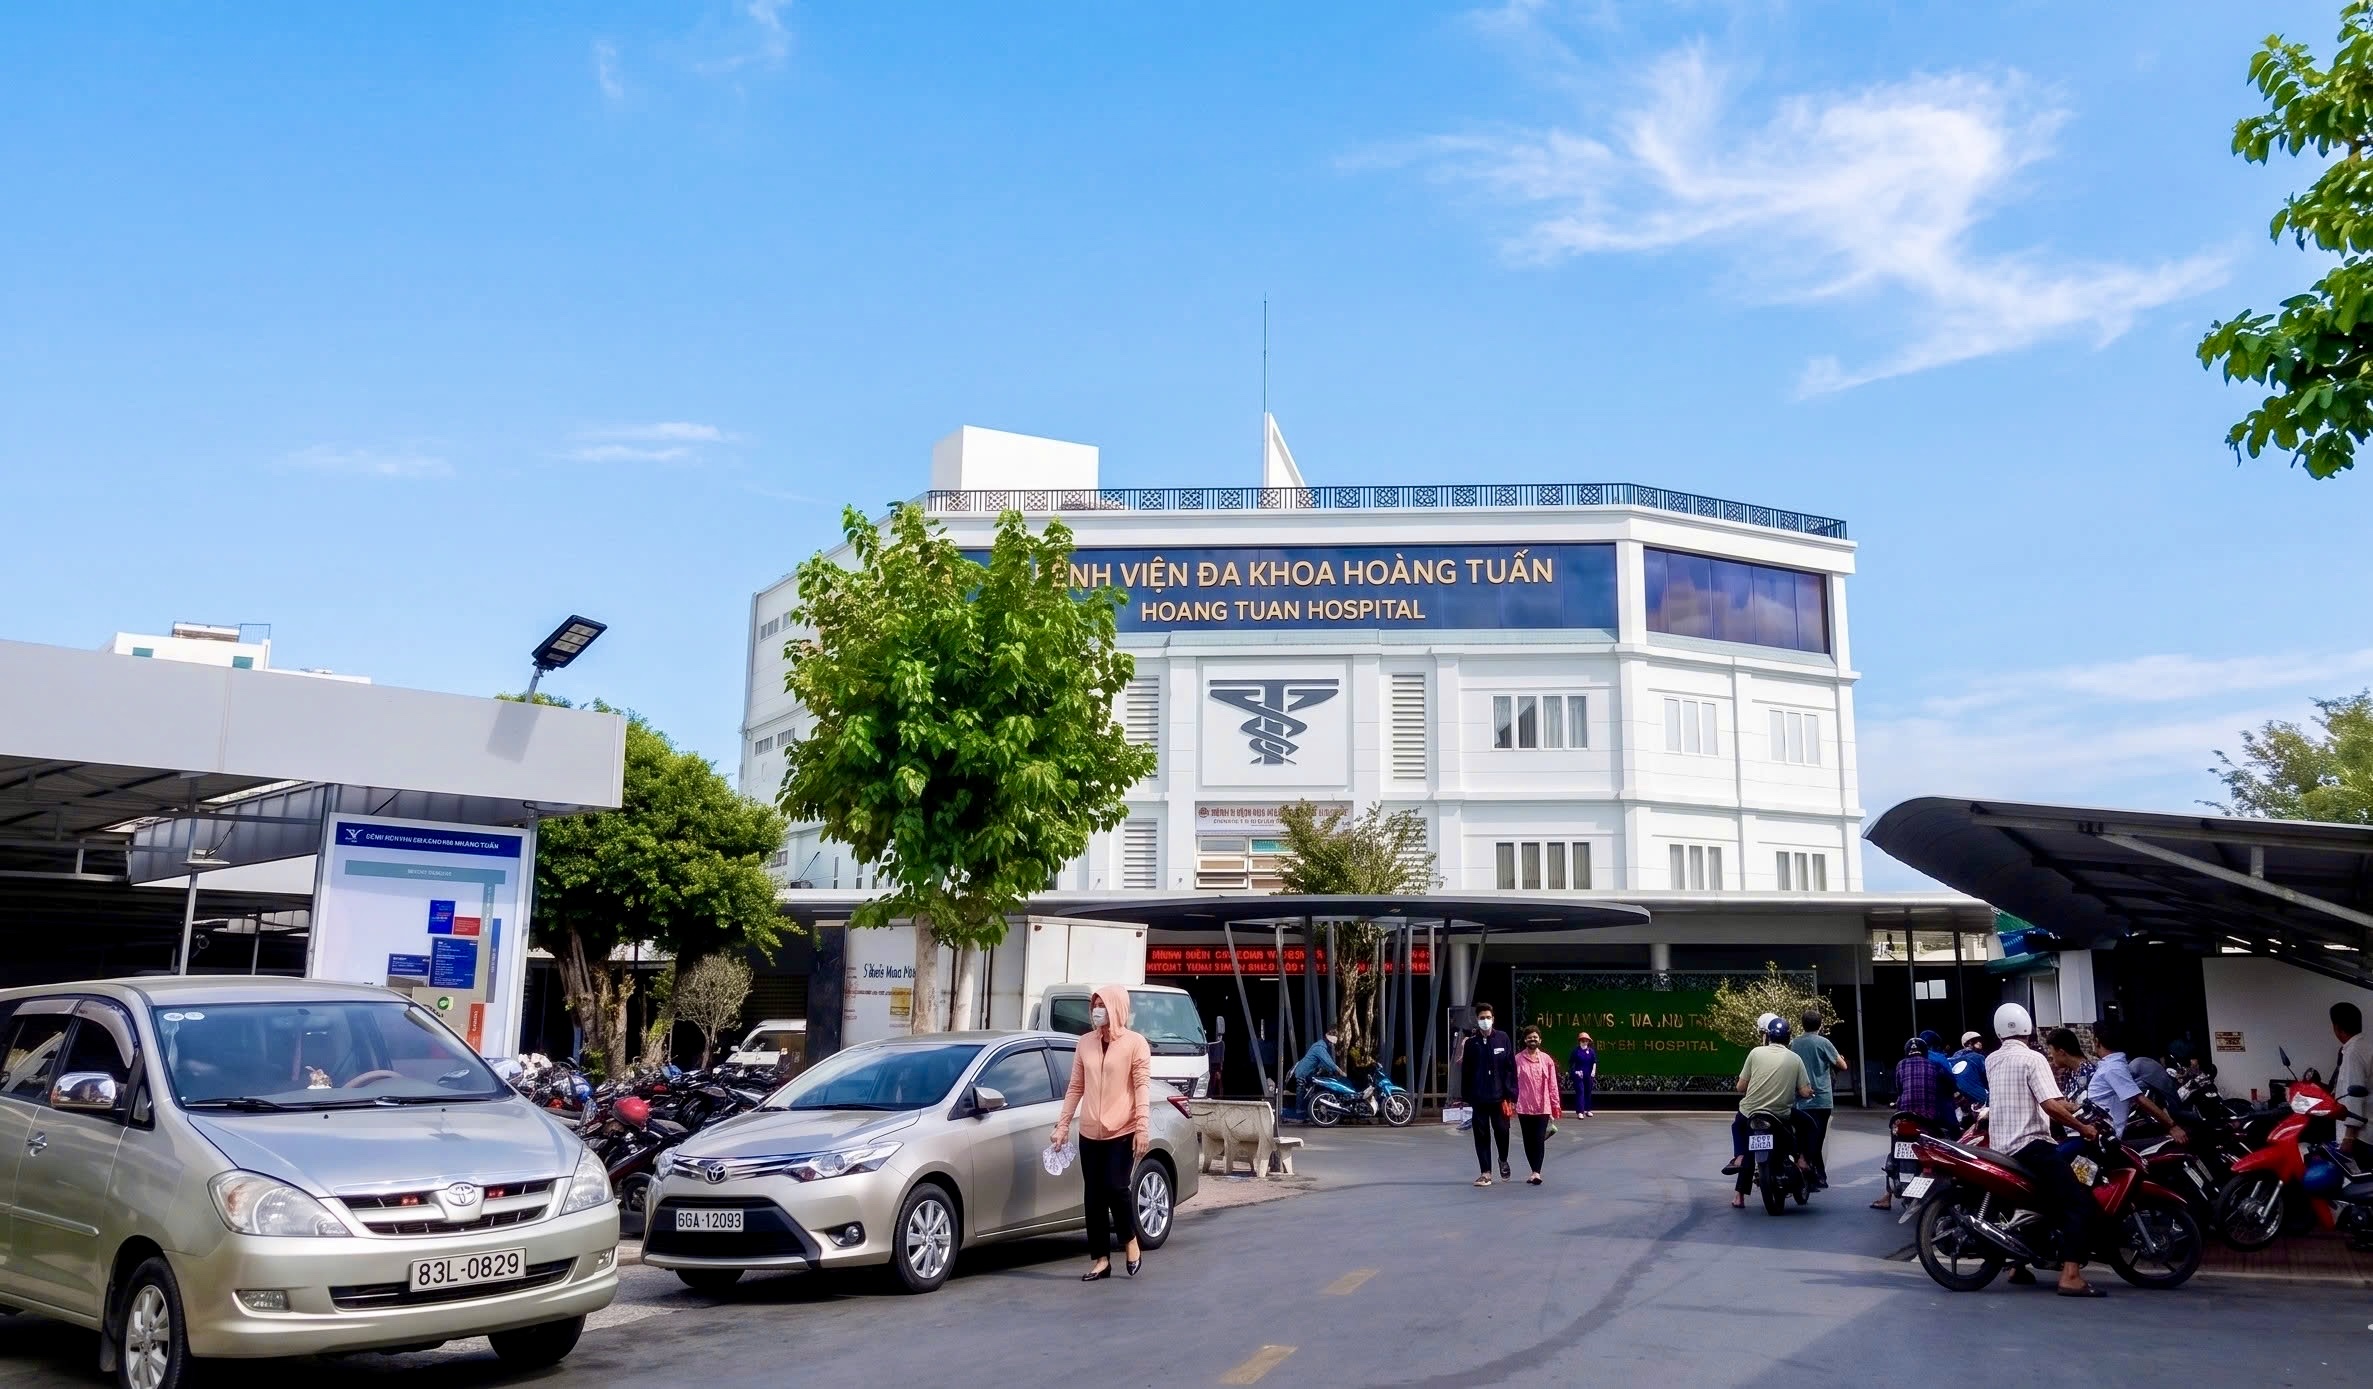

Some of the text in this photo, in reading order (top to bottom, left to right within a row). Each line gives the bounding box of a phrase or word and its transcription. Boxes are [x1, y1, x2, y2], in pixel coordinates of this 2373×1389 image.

[1120, 556, 1188, 593] VIỆN
[1197, 561, 1241, 587] ĐA
[1250, 560, 1337, 586] KHOA
[1344, 553, 1457, 585] HOÀNG
[1465, 549, 1553, 584] TUẤN
[1142, 600, 1426, 622] HOANG TUAN HOSPITAL
[1644, 1040, 1719, 1051] HOSPITAL
[418, 1252, 519, 1286] 83L-0829
